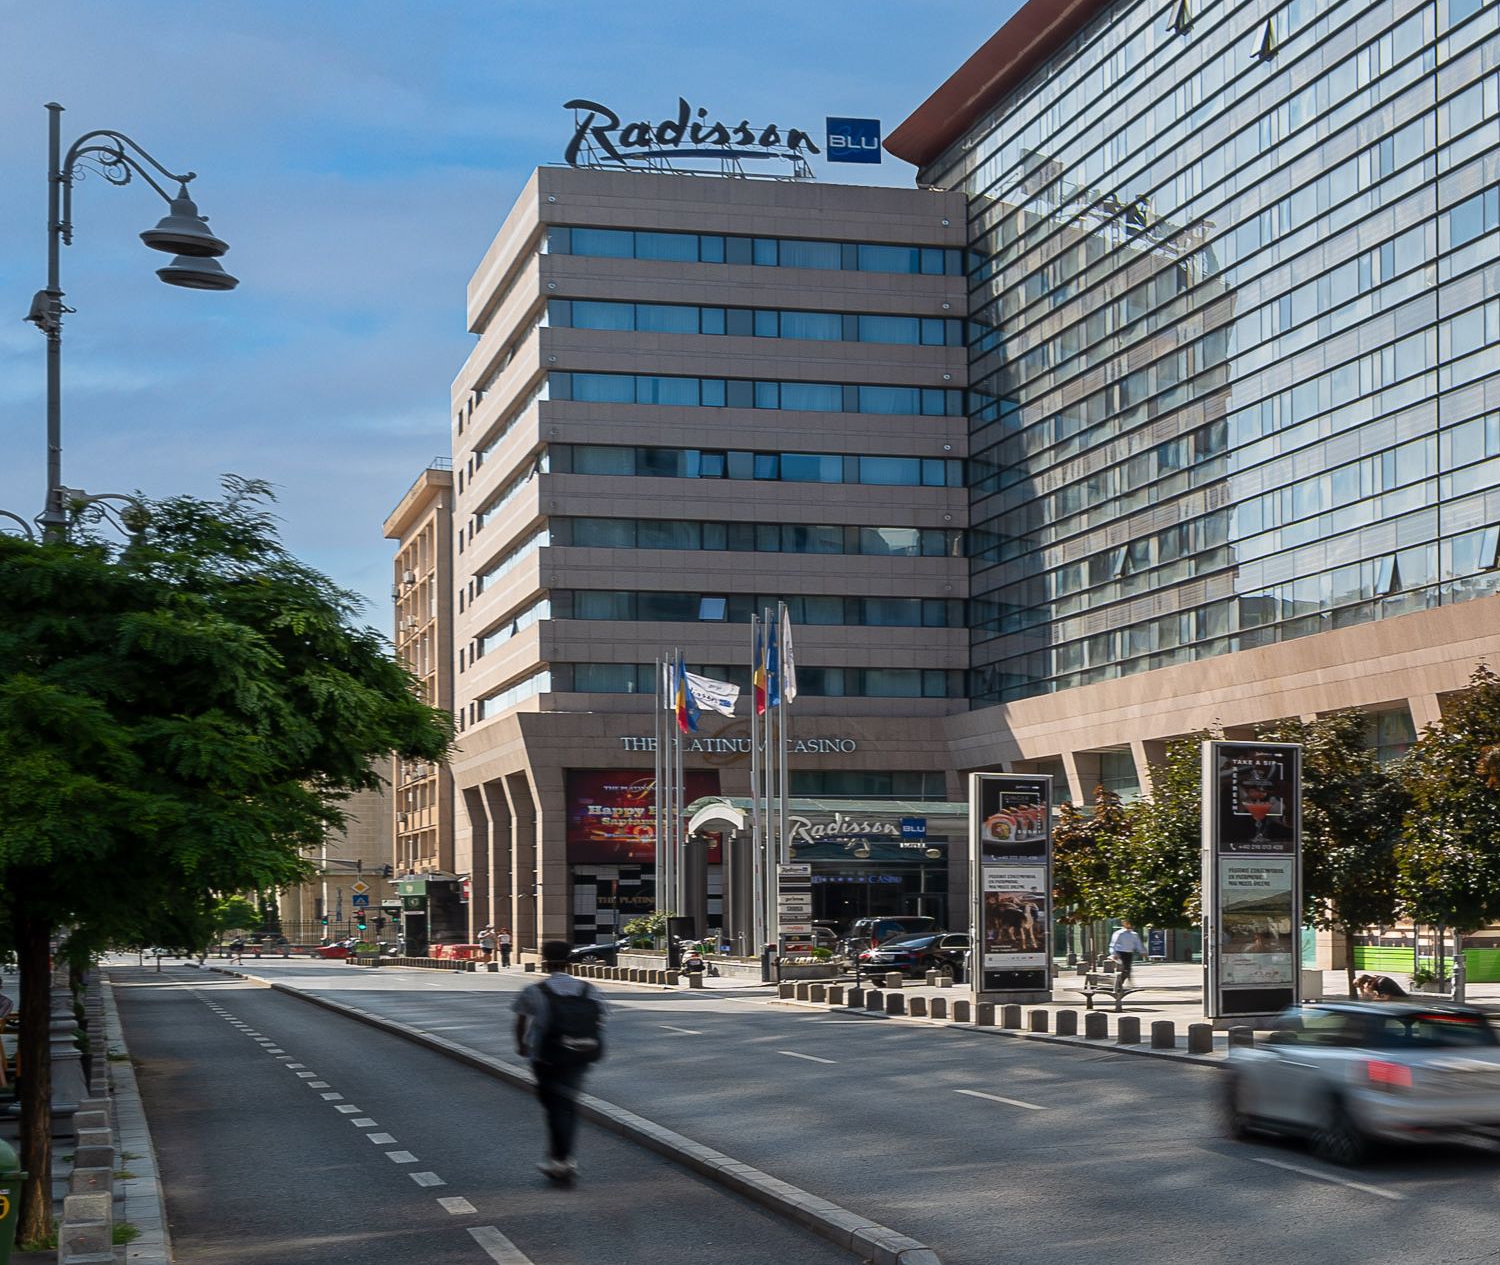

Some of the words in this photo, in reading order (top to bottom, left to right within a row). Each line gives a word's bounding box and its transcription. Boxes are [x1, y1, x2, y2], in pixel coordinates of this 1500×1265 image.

[562, 96, 821, 166] Radisson
[829, 135, 878, 150] BLU
[587, 805, 645, 817] Happy
[788, 813, 900, 846] Radisson
